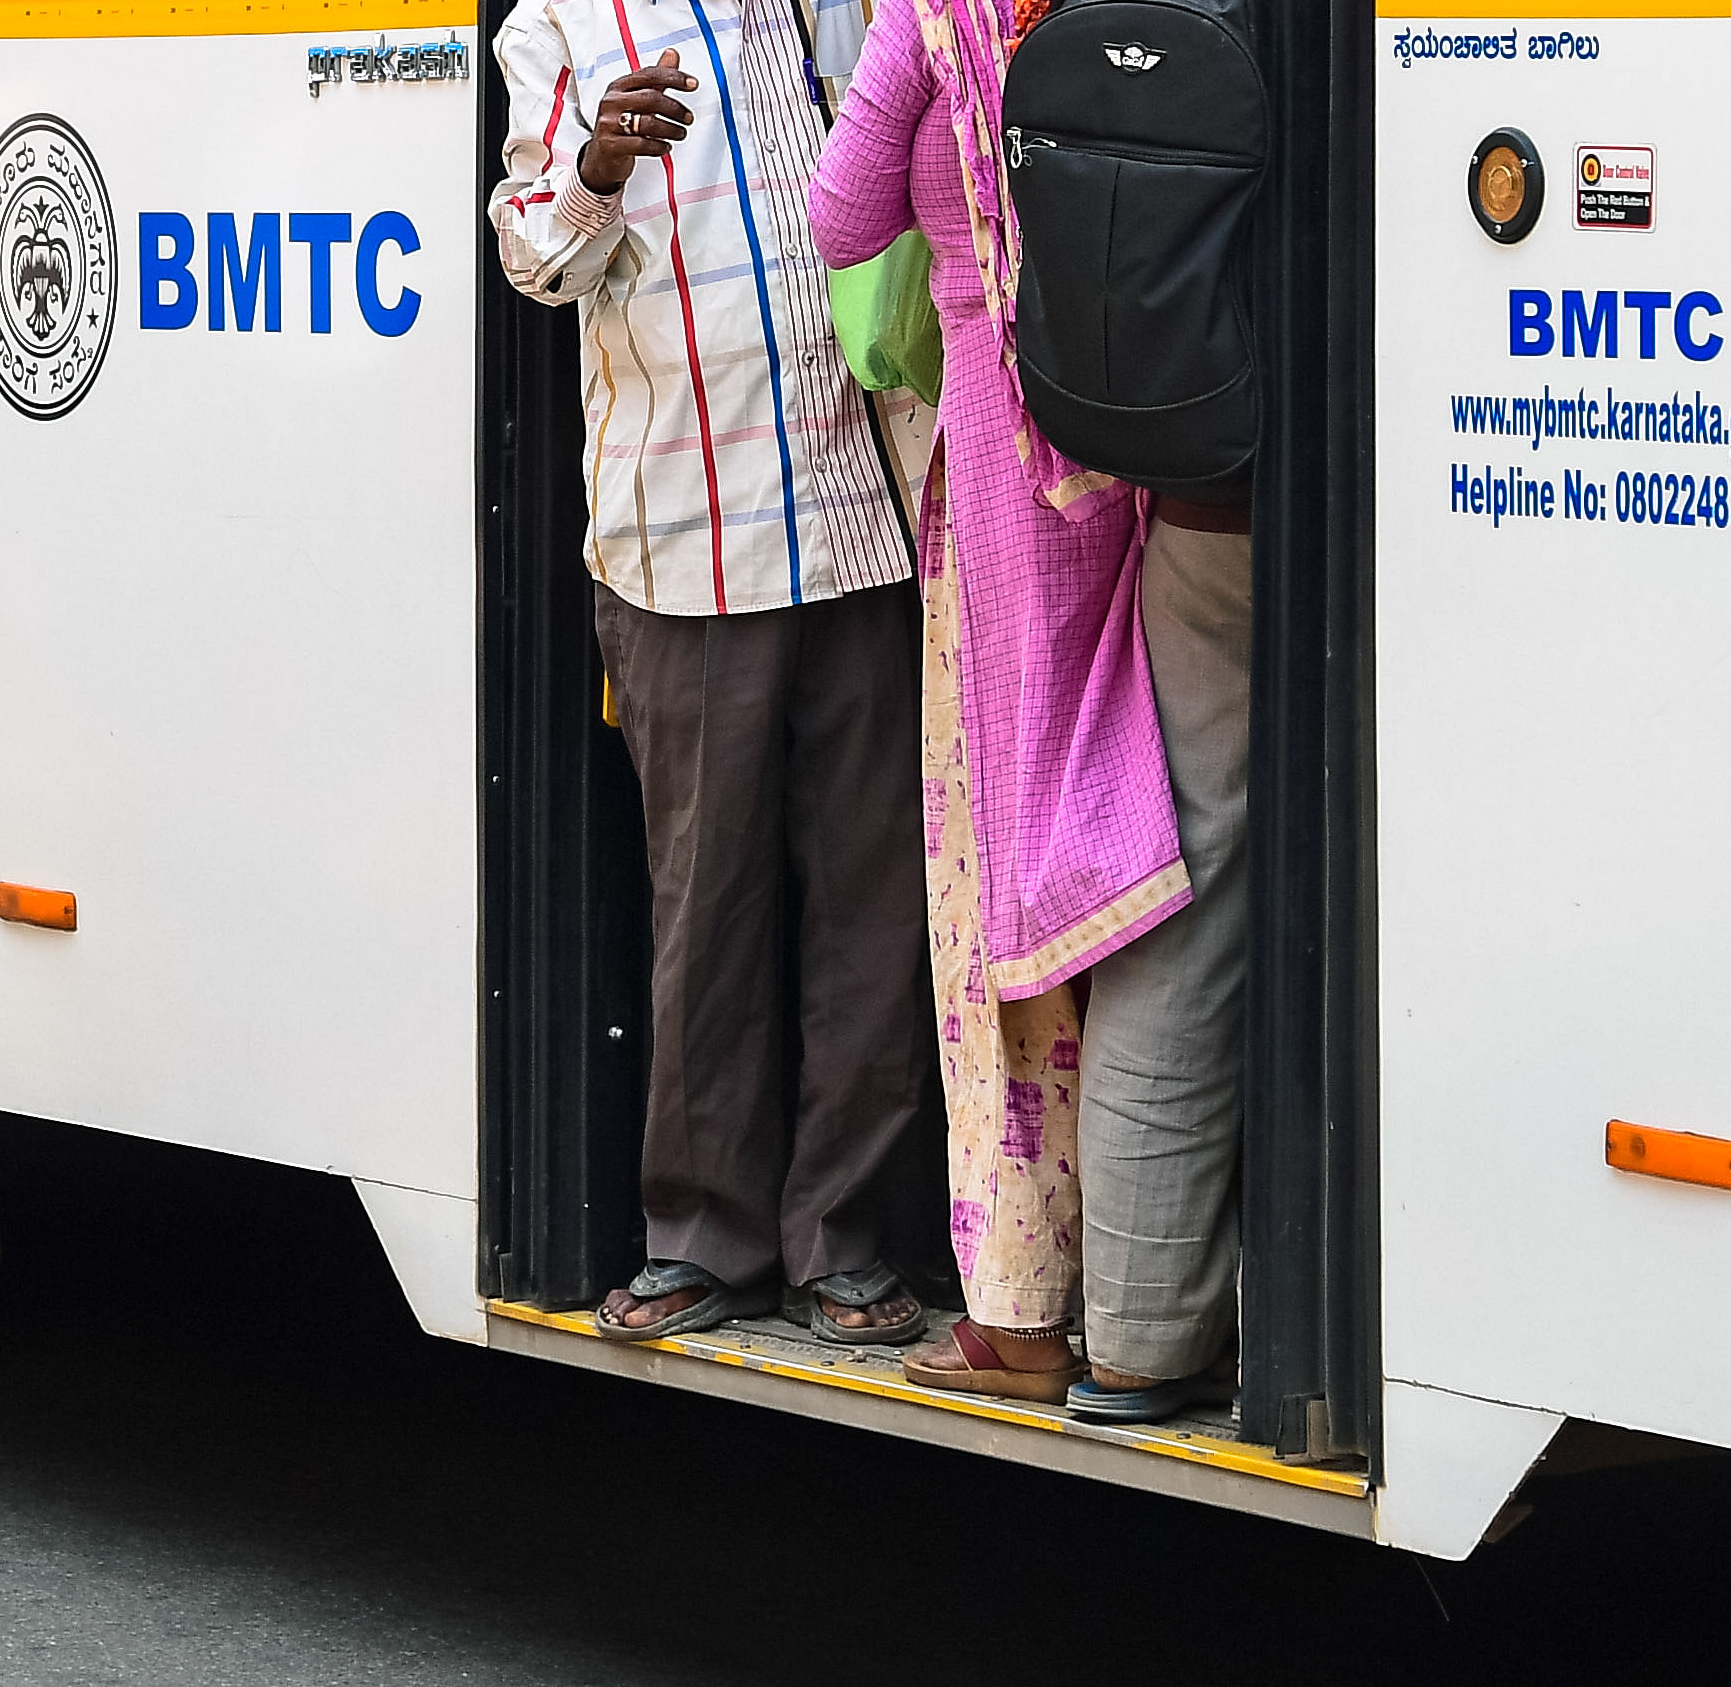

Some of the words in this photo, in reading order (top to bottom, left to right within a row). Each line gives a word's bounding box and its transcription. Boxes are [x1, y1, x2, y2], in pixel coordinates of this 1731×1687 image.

[307, 29, 470, 98] prakash
[1393, 26, 1518, 69] ಸ್ವಯಂಚಾಲಿತ
[1527, 31, 1600, 60] ಬಾಗಿಲು
[139, 211, 422, 338] BMTC
[1509, 289, 1725, 362] BMTC
[1450, 463, 1555, 529] Helpline
[1564, 468, 1607, 524] No:
